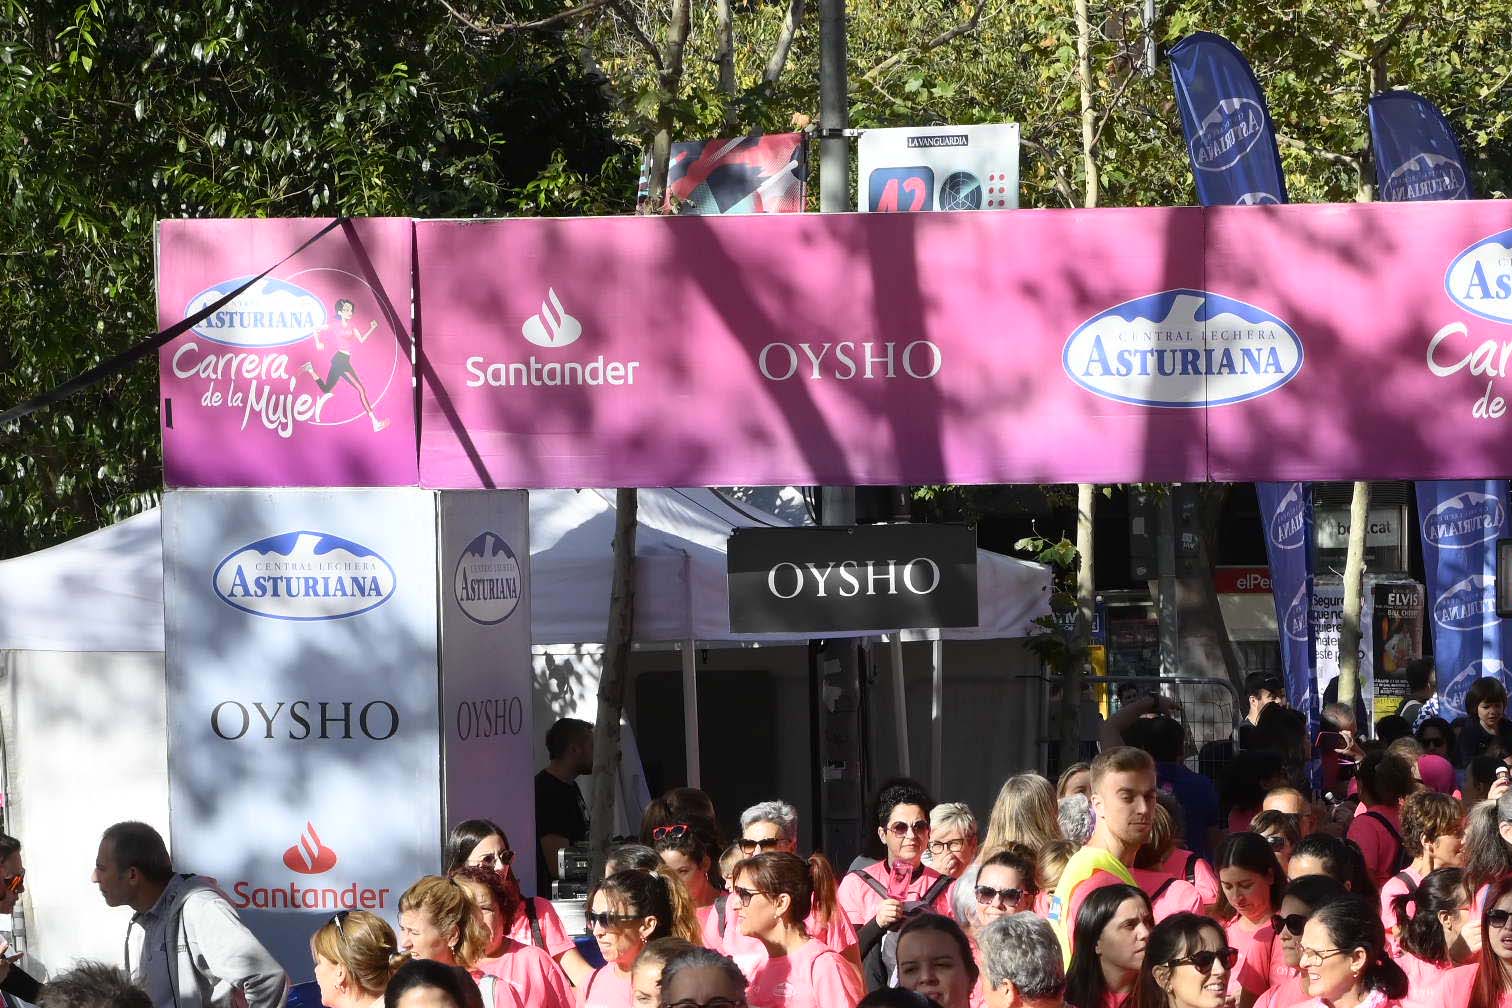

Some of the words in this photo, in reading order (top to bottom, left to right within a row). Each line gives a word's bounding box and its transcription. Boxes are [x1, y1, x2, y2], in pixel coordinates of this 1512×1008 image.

[173, 342, 289, 379] Carrera
[466, 355, 639, 387] Santander
[758, 340, 942, 382] OYSHO
[1081, 334, 1285, 377] ASTURIANA
[201, 382, 222, 407] de
[227, 382, 243, 407] la
[241, 376, 334, 438] Mujer
[1472, 380, 1507, 419] de
[228, 562, 383, 599] ASTURIANA
[460, 566, 517, 601] ASTURIANA
[768, 556, 941, 598] OYSHO
[1236, 573, 1273, 589] elPe
[1312, 594, 1344, 608] Segur
[1388, 593, 1418, 606] ELVIS
[210, 699, 399, 741] OYSHO
[457, 697, 522, 741] OYSHO
[234, 880, 389, 909] Santander
